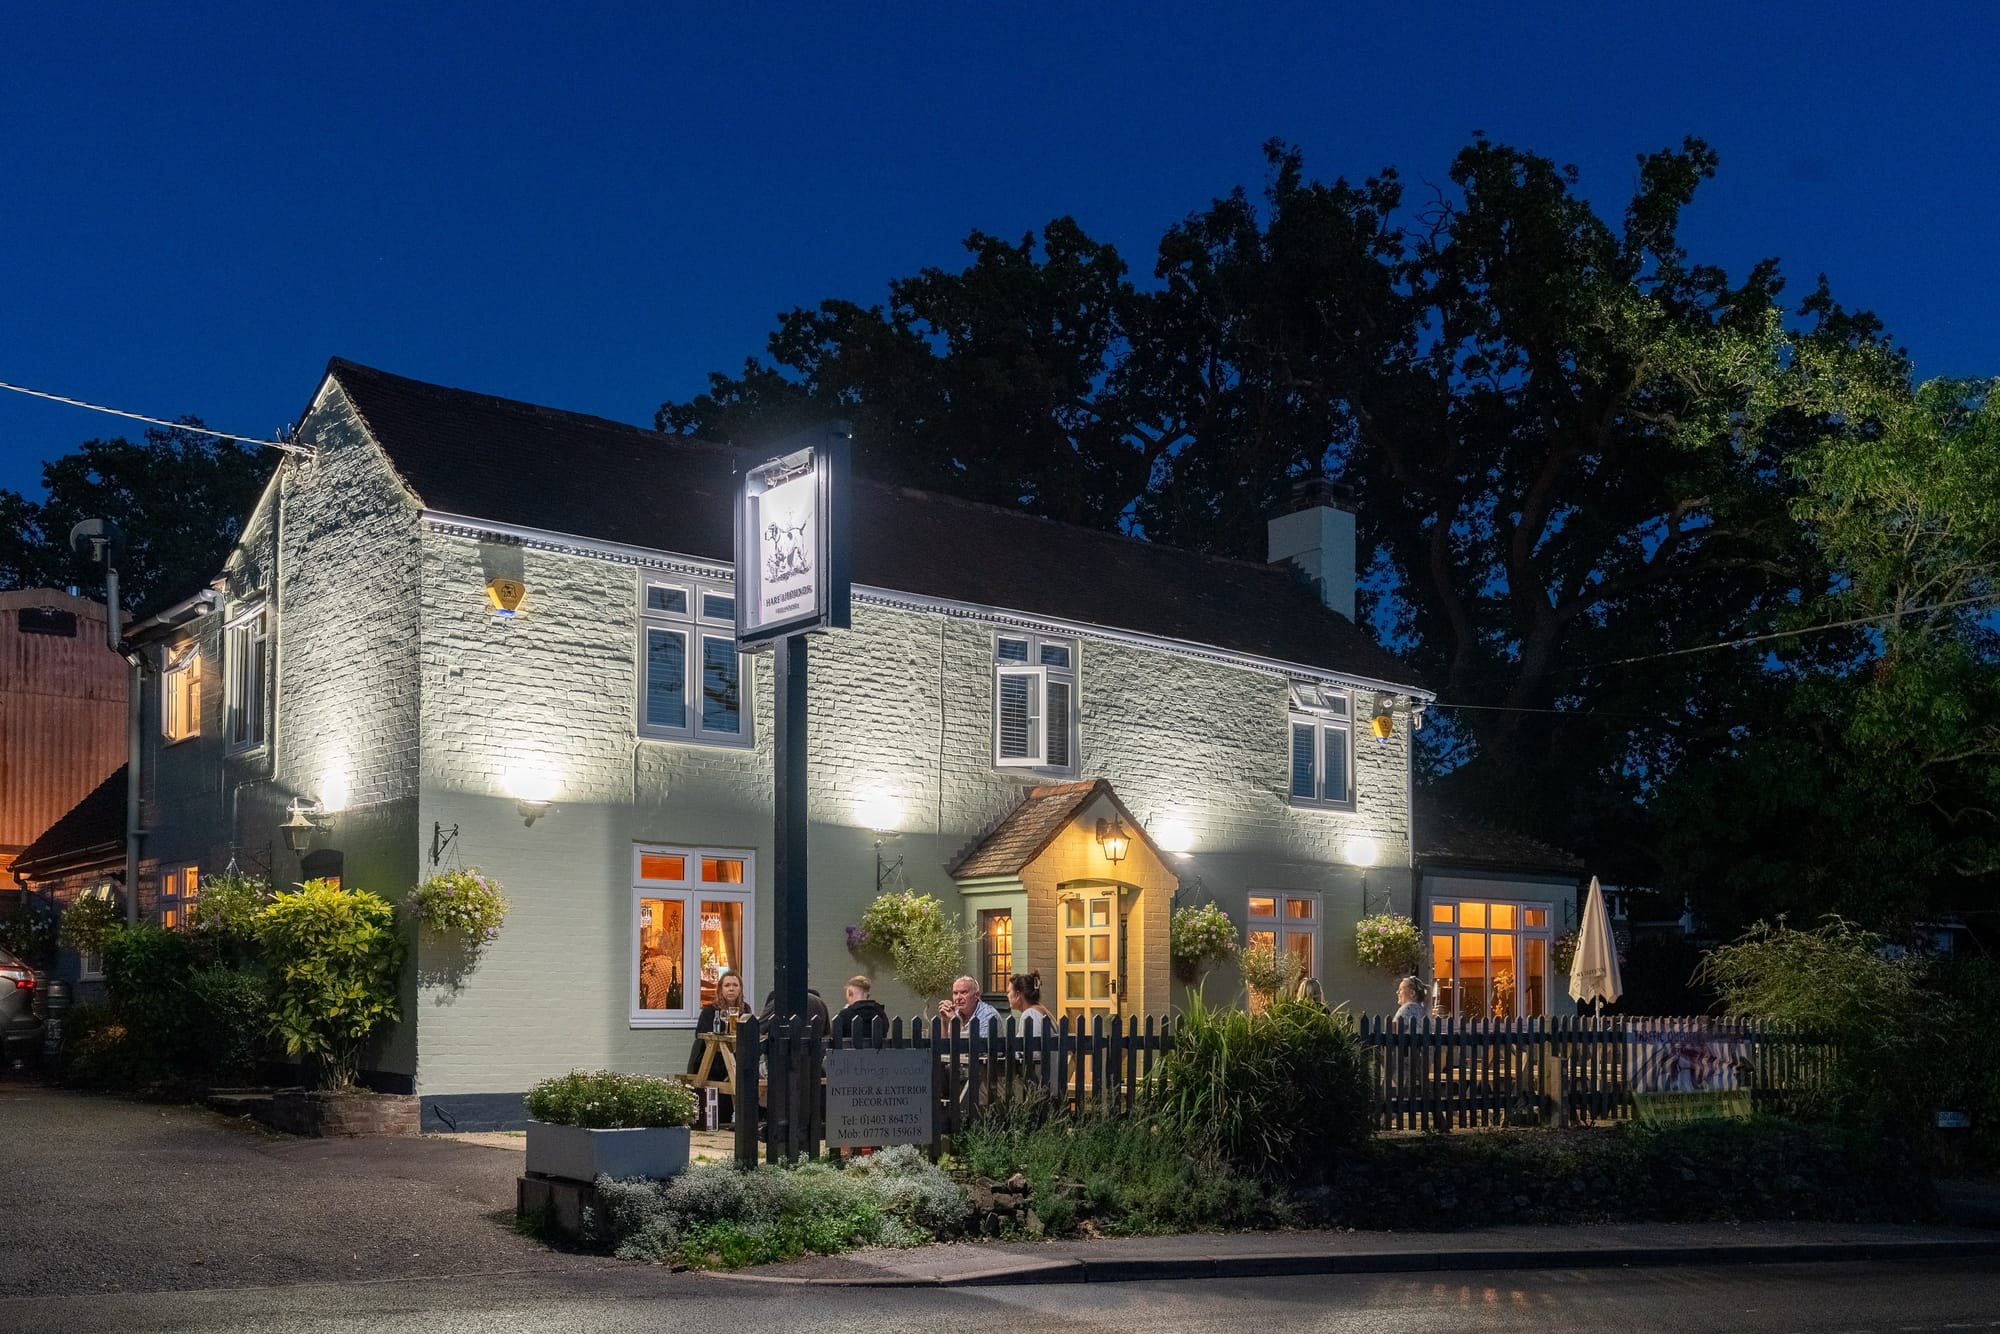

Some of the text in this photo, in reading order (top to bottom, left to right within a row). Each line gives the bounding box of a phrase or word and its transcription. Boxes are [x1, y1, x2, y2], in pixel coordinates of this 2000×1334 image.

[853, 1058, 889, 1079] things
[831, 1086, 928, 1096] INTERIOR & EXTERIOR
[852, 1097, 909, 1107] DECORATING
[1650, 1095, 1666, 1104] WILL
[1668, 1094, 1684, 1104] COST
[841, 1113, 920, 1126] Tel: 01403 864735
[838, 1127, 922, 1139] Mob: 07778 159618
